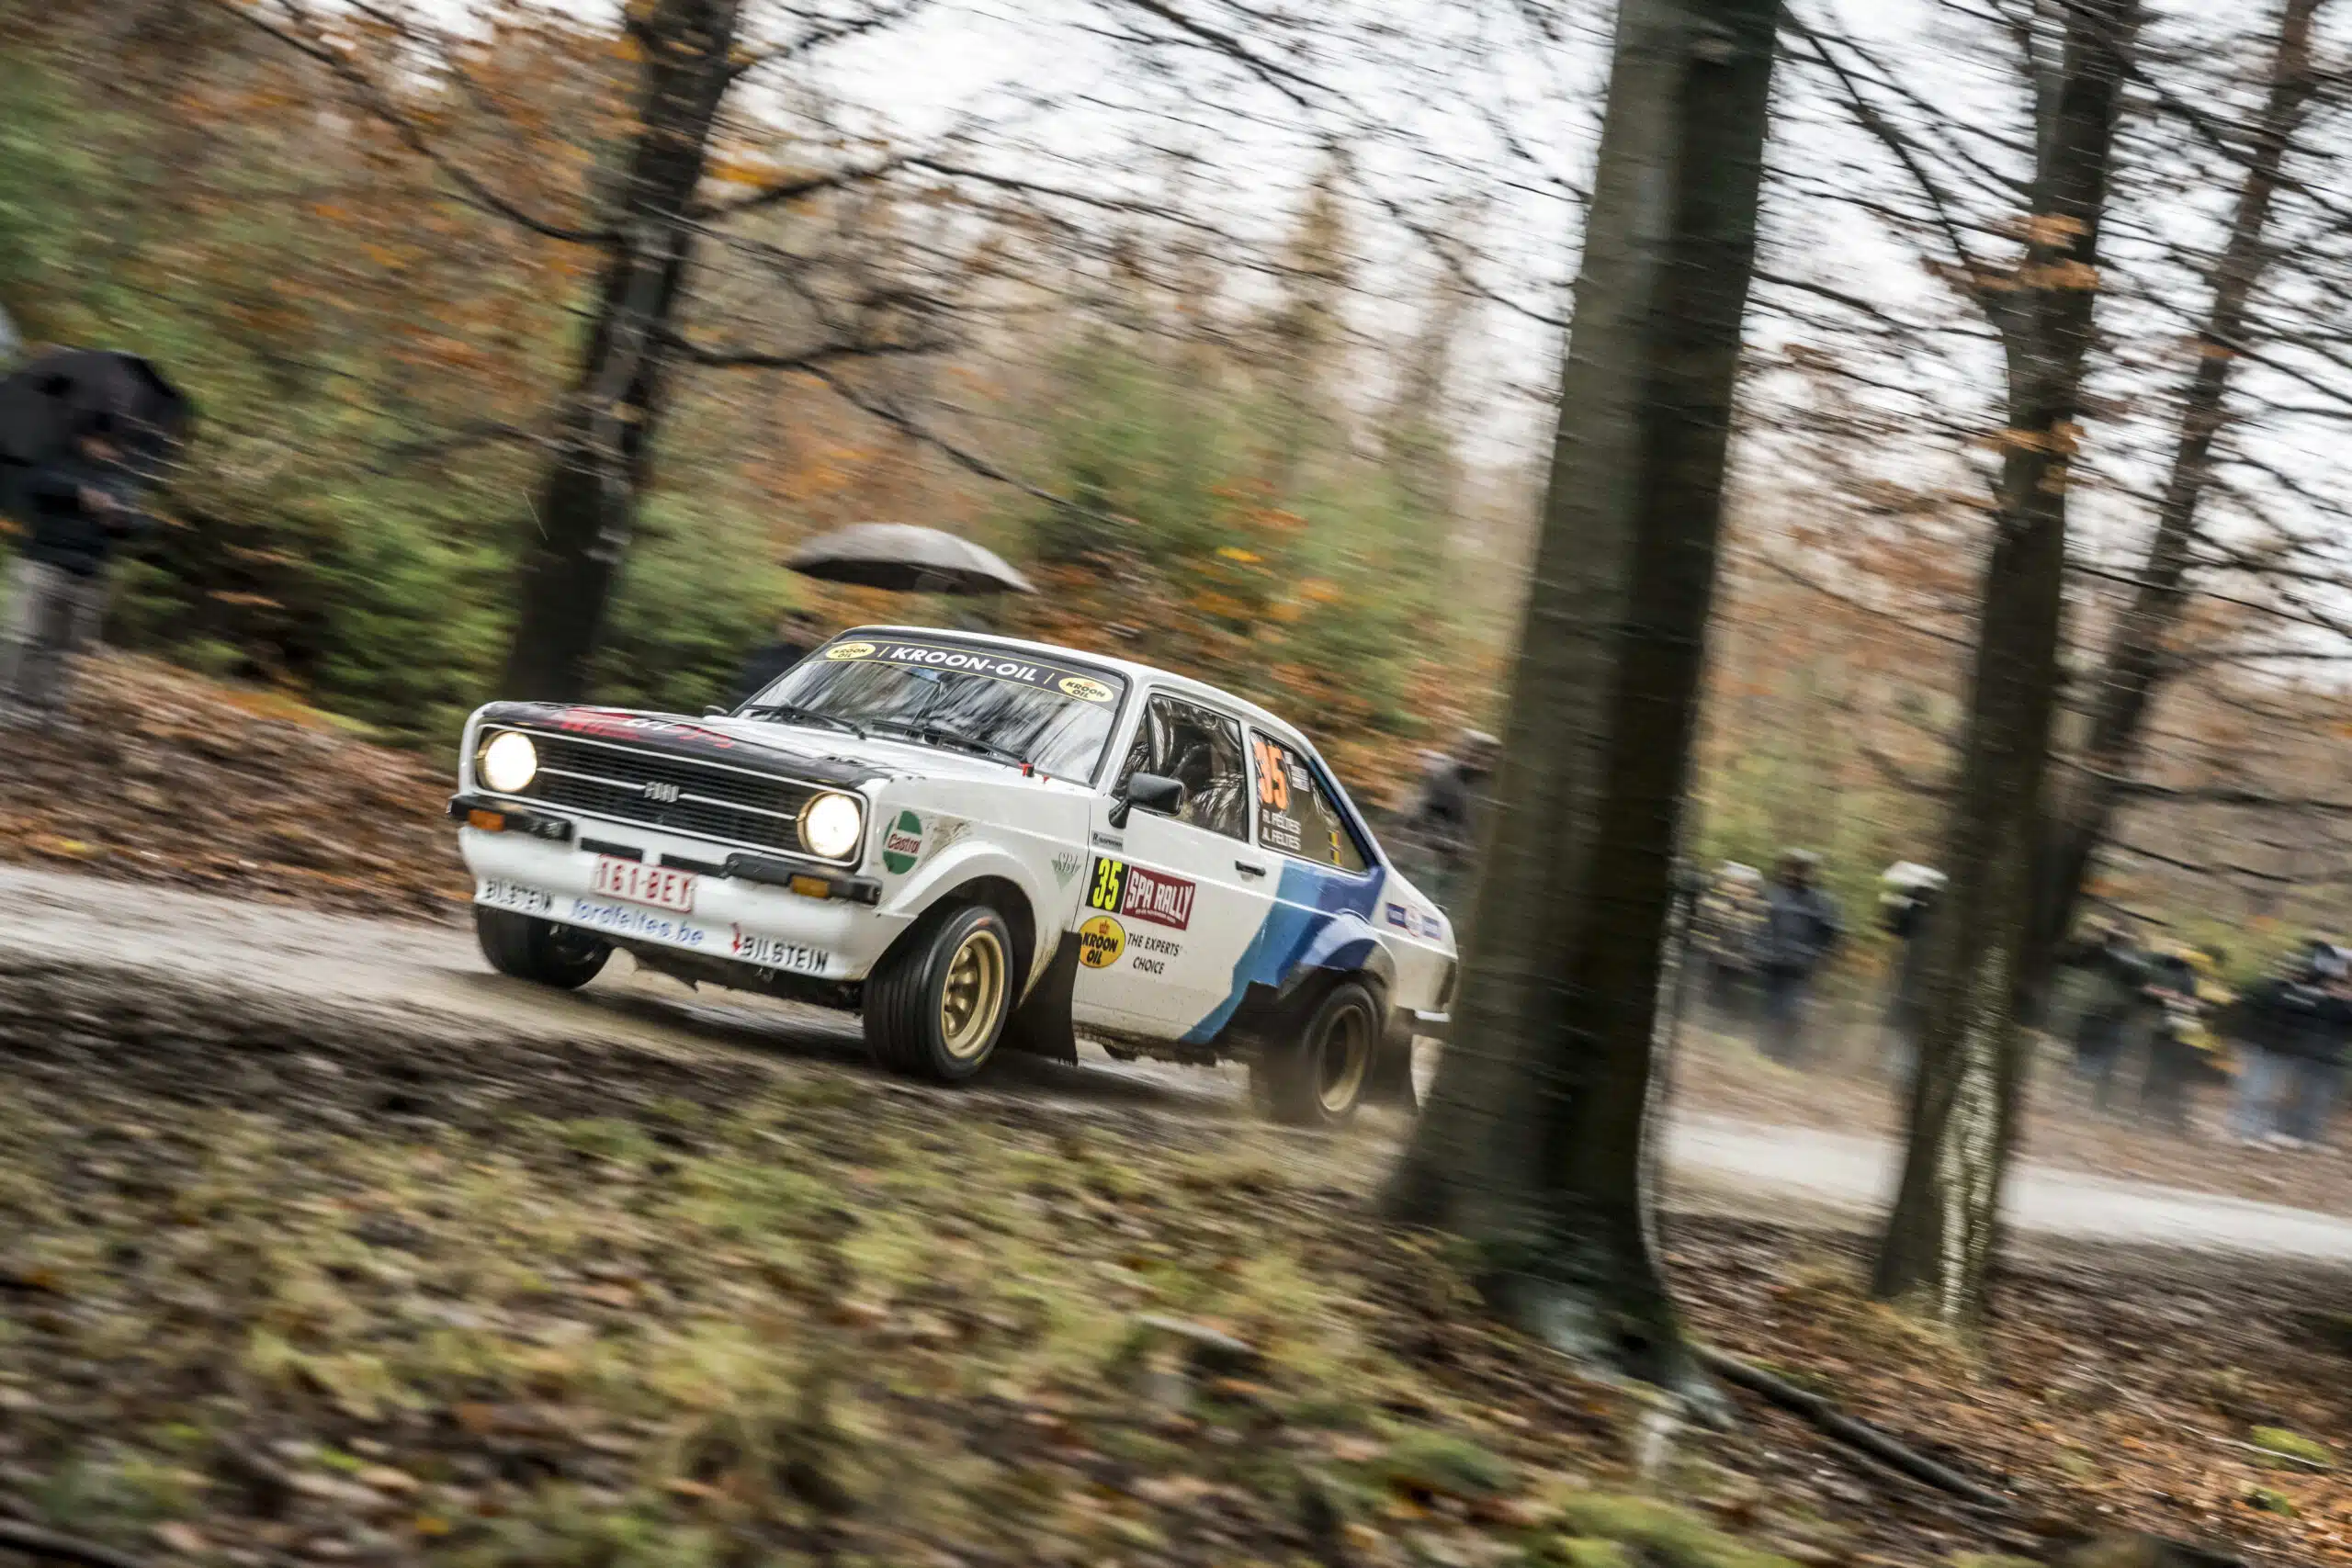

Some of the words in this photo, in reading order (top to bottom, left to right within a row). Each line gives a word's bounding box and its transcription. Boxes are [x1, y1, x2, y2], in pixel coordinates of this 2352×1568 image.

[889, 647, 1037, 682] KROON-OIL
[1066, 681, 1106, 698] KROON
[1072, 689, 1090, 699] OIL
[1253, 739, 1288, 810] 35
[1271, 811, 1302, 836] FELTES
[888, 832, 922, 855] Castrol
[1271, 829, 1302, 852] FELTES
[1091, 857, 1123, 911] 35
[1125, 870, 1155, 909] SPA
[1153, 883, 1193, 923] RALLY
[571, 897, 704, 946] fordfeltes.be
[1081, 931, 1119, 953] KROON
[1126, 932, 1144, 948] THE
[740, 934, 830, 973] BILSTEIN
[1086, 947, 1102, 964] OIL
[1132, 956, 1165, 975] CHOICE
